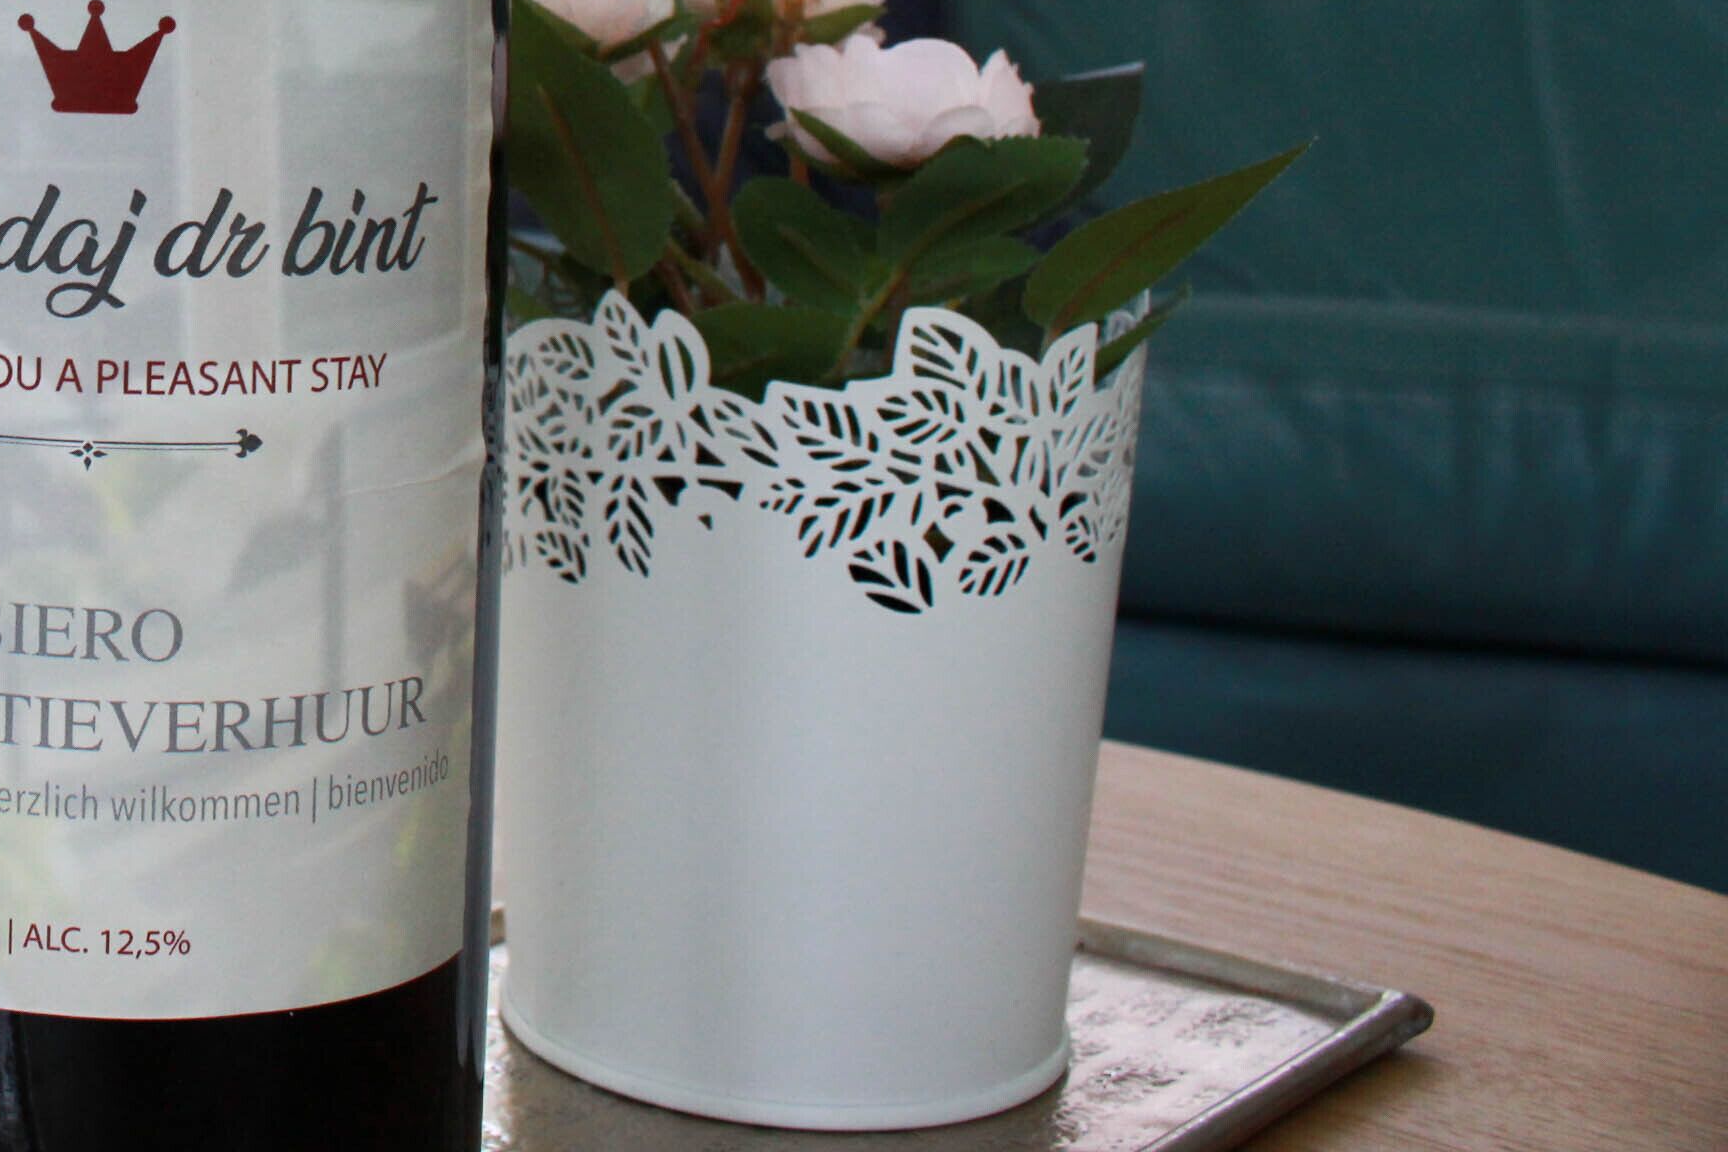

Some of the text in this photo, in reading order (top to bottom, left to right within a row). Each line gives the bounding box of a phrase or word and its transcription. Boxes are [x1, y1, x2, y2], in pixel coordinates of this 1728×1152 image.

[153, 187, 271, 279] dr
[281, 181, 439, 277] bint
[55, 357, 84, 394] A
[96, 358, 303, 397] PLEASANT
[310, 352, 388, 393] STAY
[111, 785, 301, 823] wilkommen
[327, 748, 450, 811] bienvenido
[22, 922, 89, 955] ALC.
[100, 929, 192, 961] 12,5%
